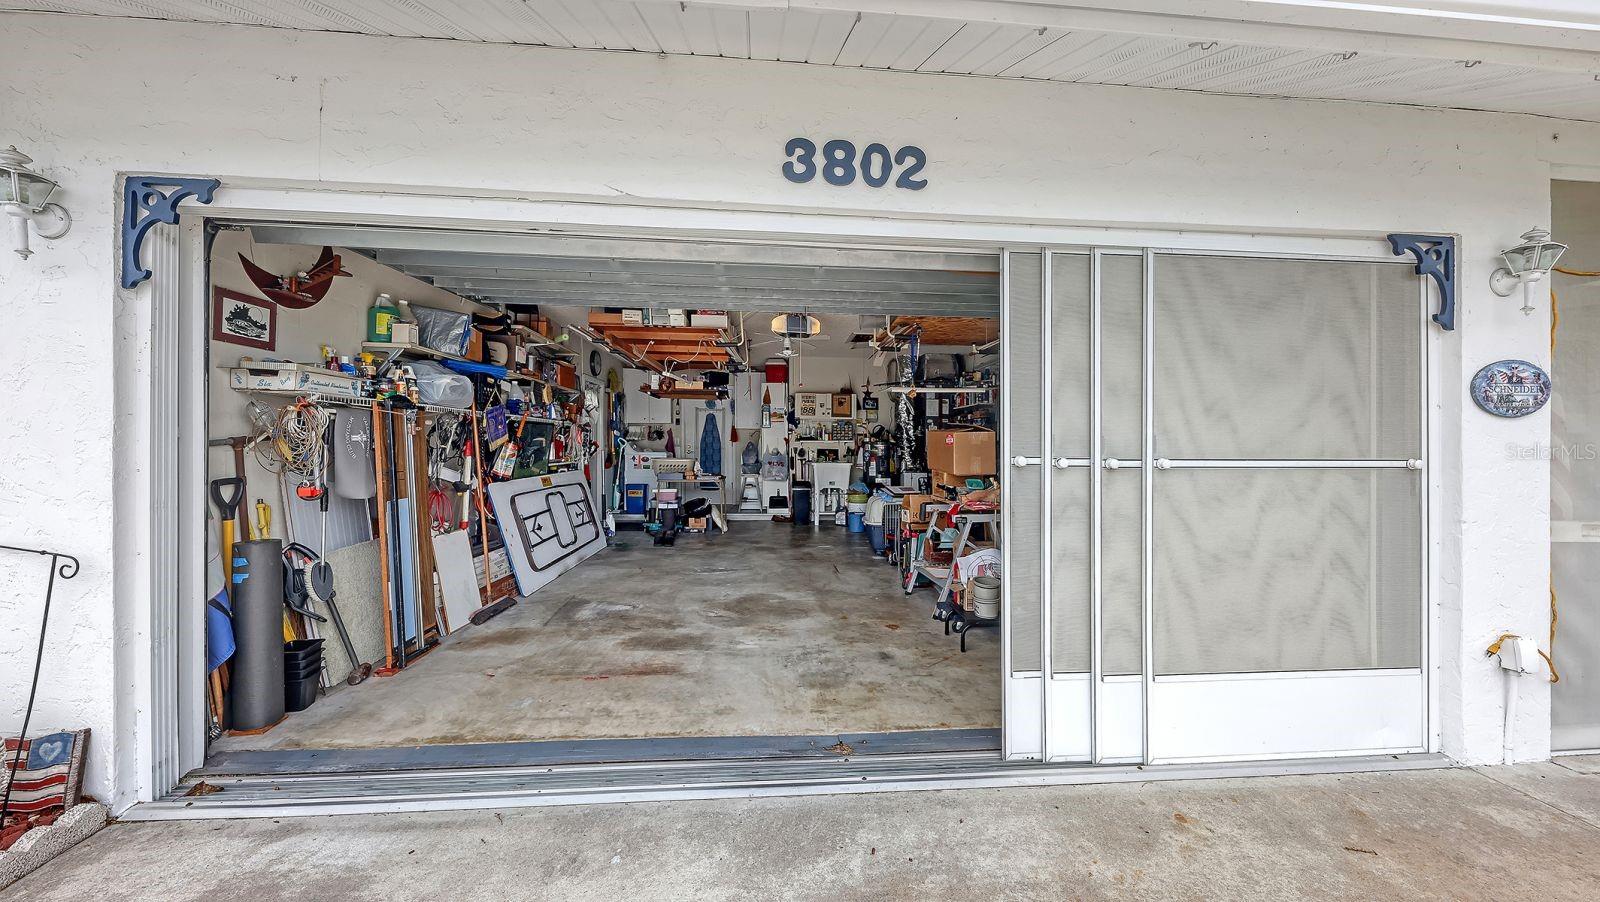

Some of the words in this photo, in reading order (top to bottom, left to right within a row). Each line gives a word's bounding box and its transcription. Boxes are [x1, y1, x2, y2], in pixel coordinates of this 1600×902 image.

[782, 137, 928, 191] 3802
[1488, 385, 1542, 394] SCHNEIDER
[346, 444, 357, 459] CLUB
